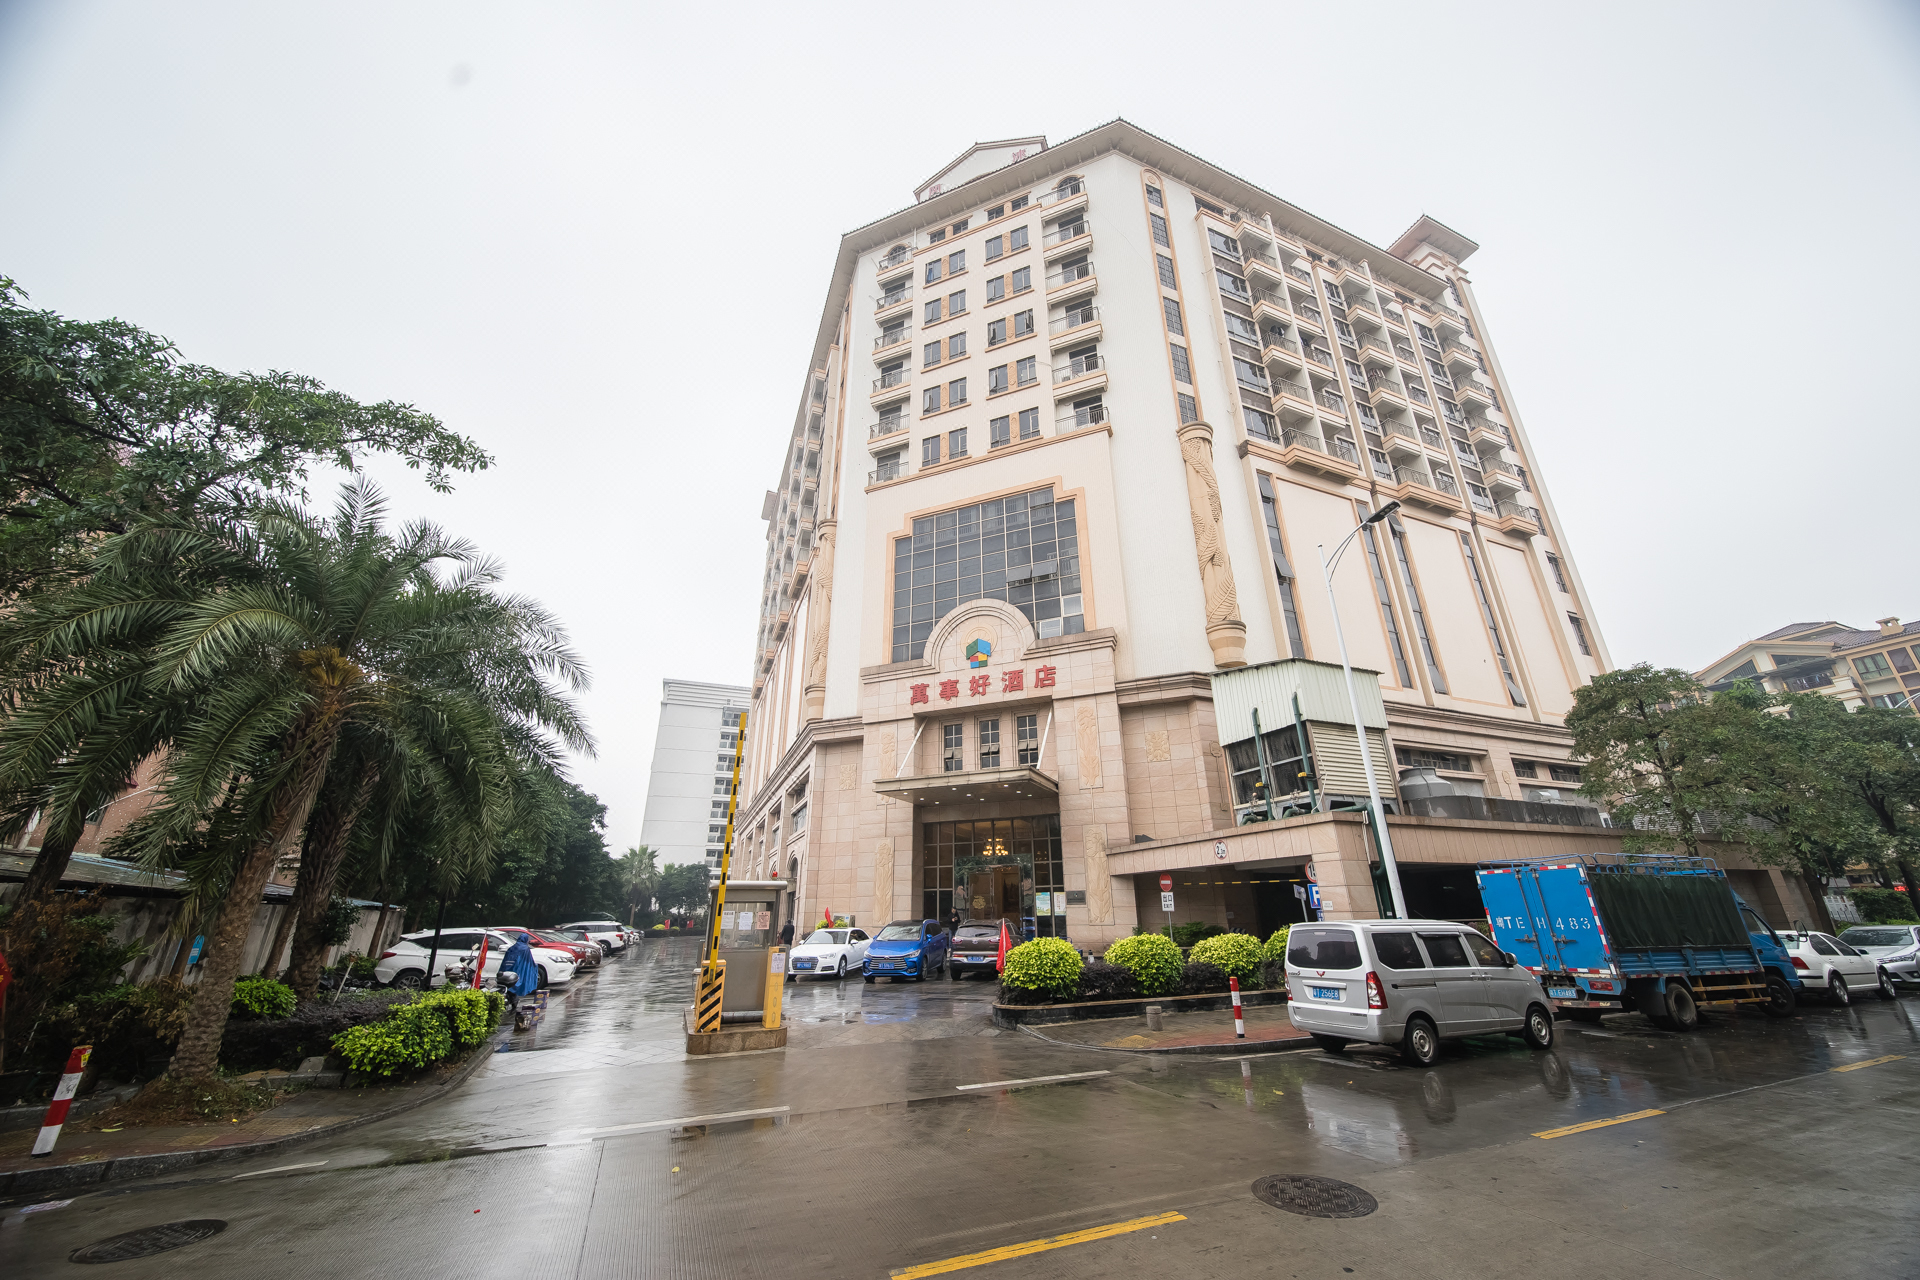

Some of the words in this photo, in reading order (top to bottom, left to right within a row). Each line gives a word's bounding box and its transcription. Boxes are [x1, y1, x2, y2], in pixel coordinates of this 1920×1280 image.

[910, 664, 1057, 706] 萬事好酒店
